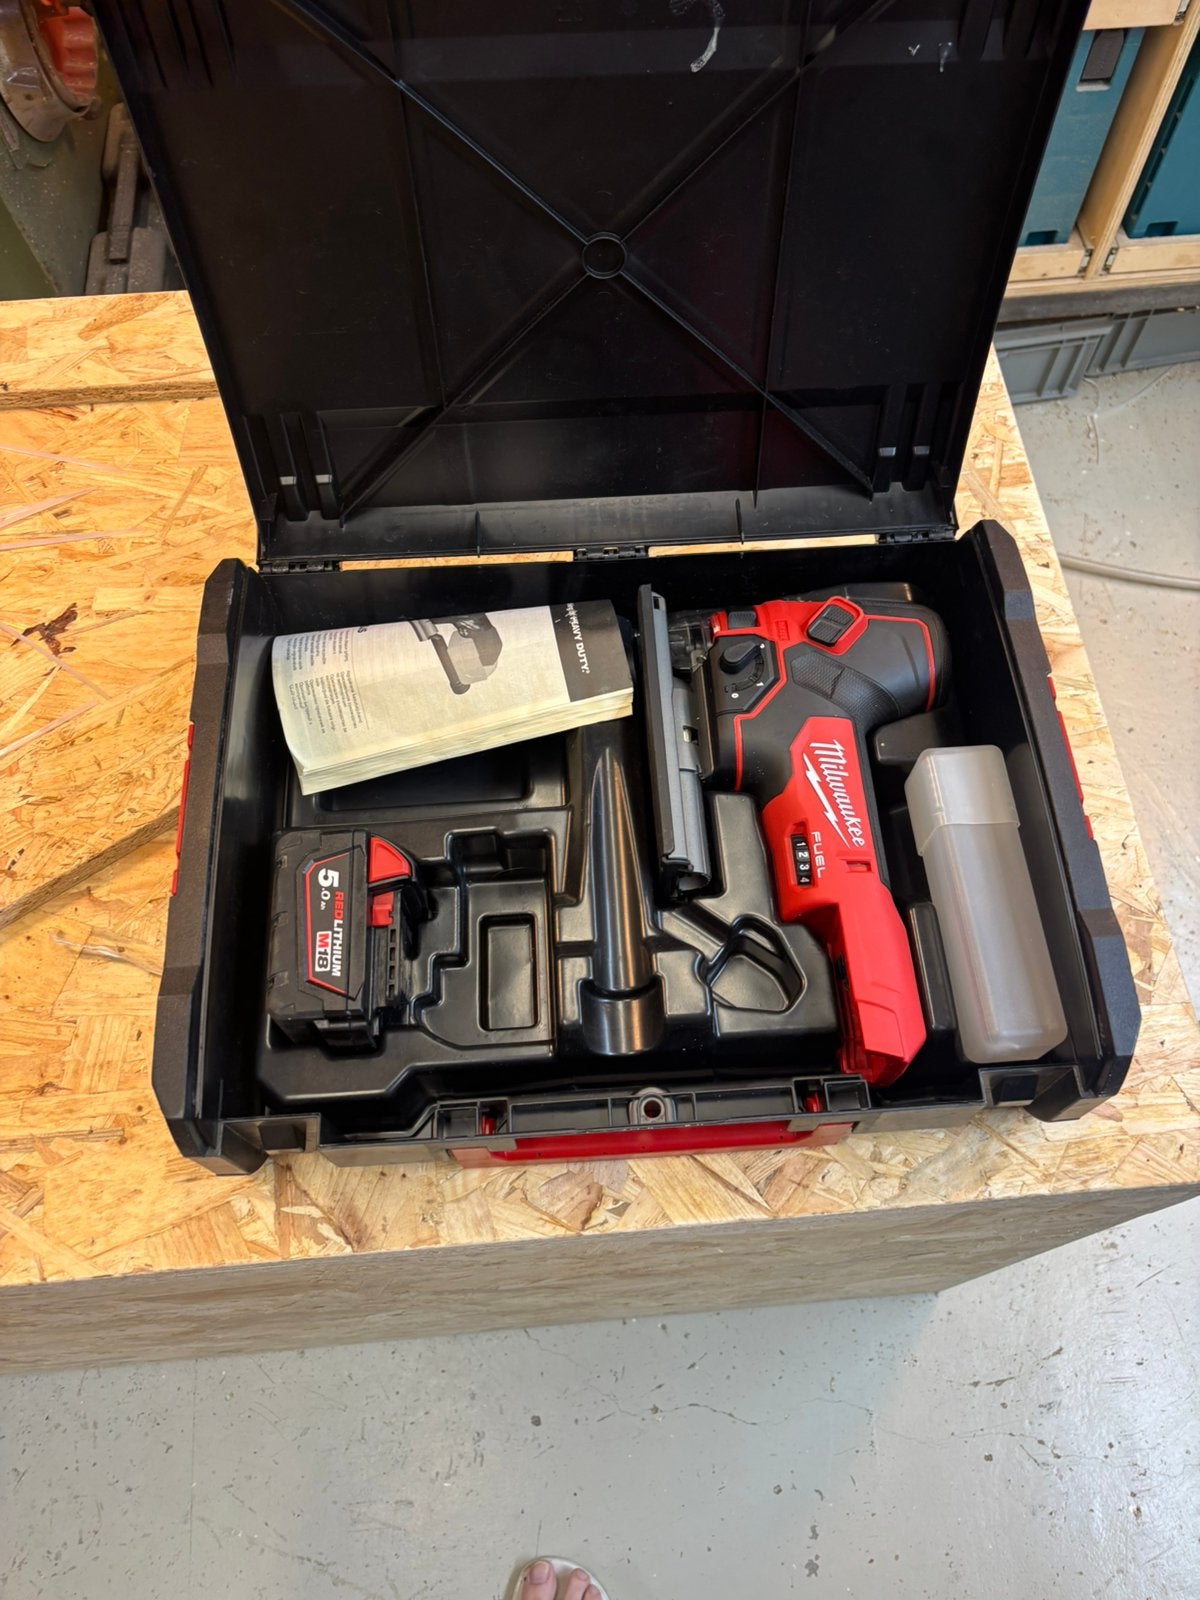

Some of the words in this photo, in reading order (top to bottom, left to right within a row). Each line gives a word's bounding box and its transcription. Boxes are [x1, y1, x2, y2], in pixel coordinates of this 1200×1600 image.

[809, 739, 865, 848] Milwaukee
[799, 863, 810, 871] 3
[811, 831, 826, 879] FUEL
[318, 867, 340, 901] 5.0
[316, 931, 331, 971] M18
